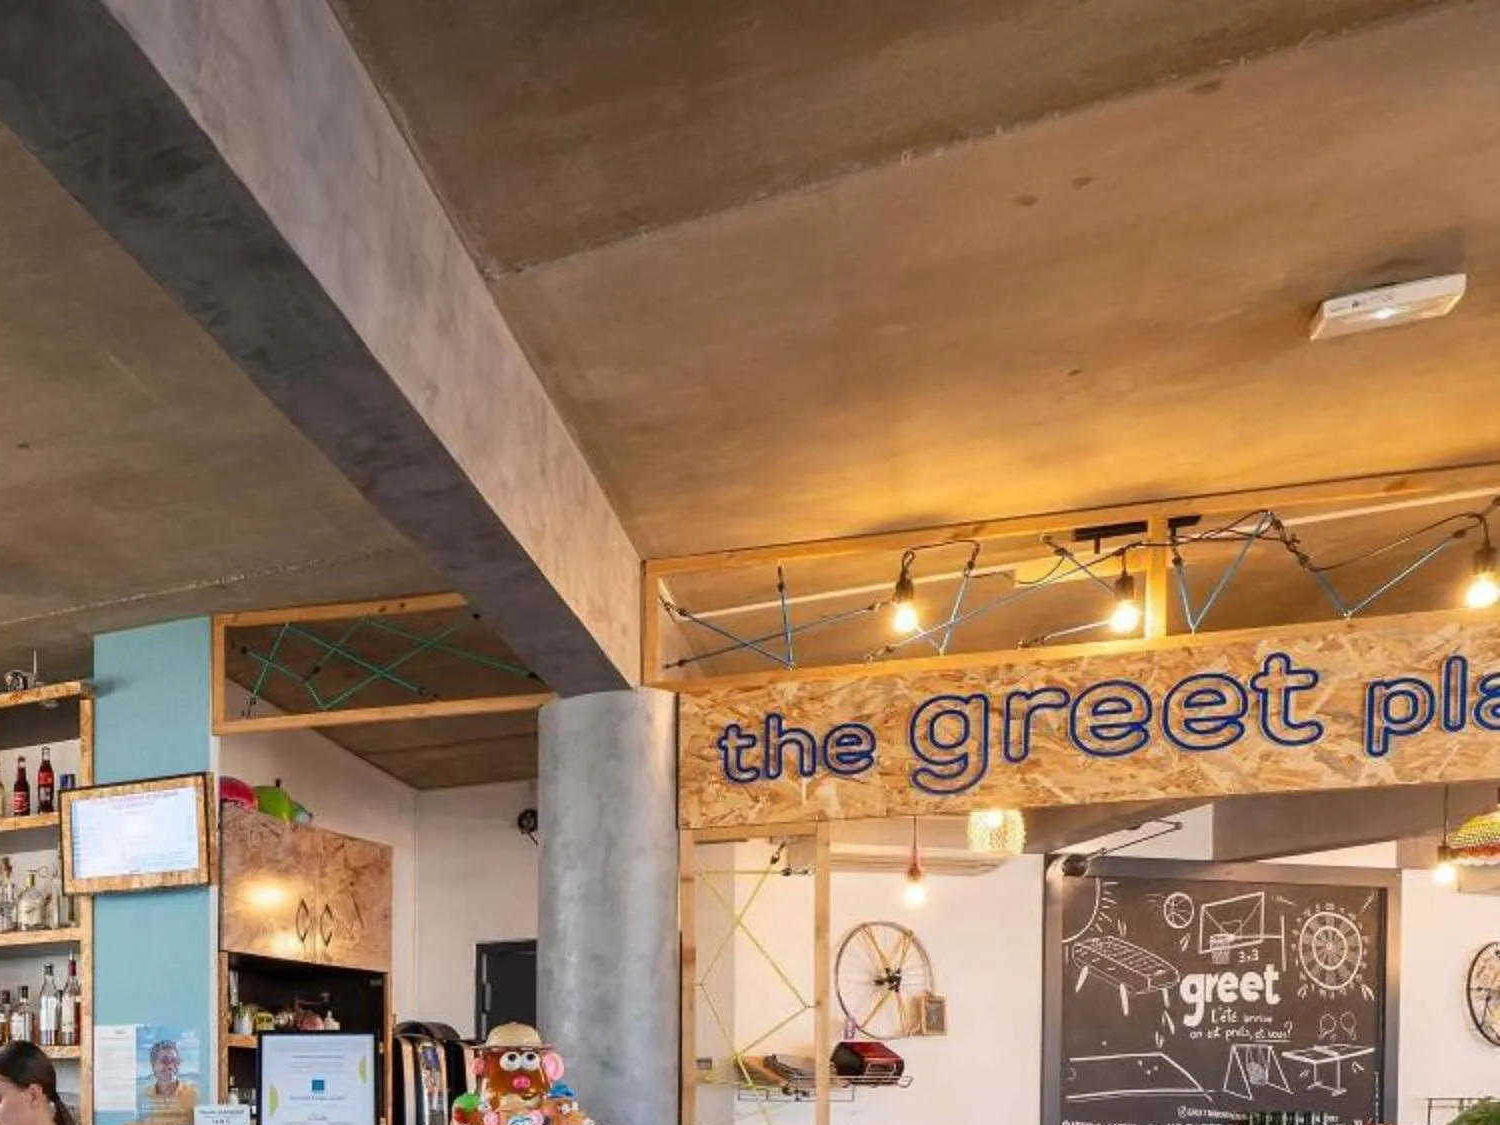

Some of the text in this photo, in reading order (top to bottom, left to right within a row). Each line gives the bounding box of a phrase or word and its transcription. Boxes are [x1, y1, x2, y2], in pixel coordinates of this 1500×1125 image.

[716, 712, 876, 784] the
[909, 651, 1324, 795] greet
[1180, 963, 1282, 1028] greet
